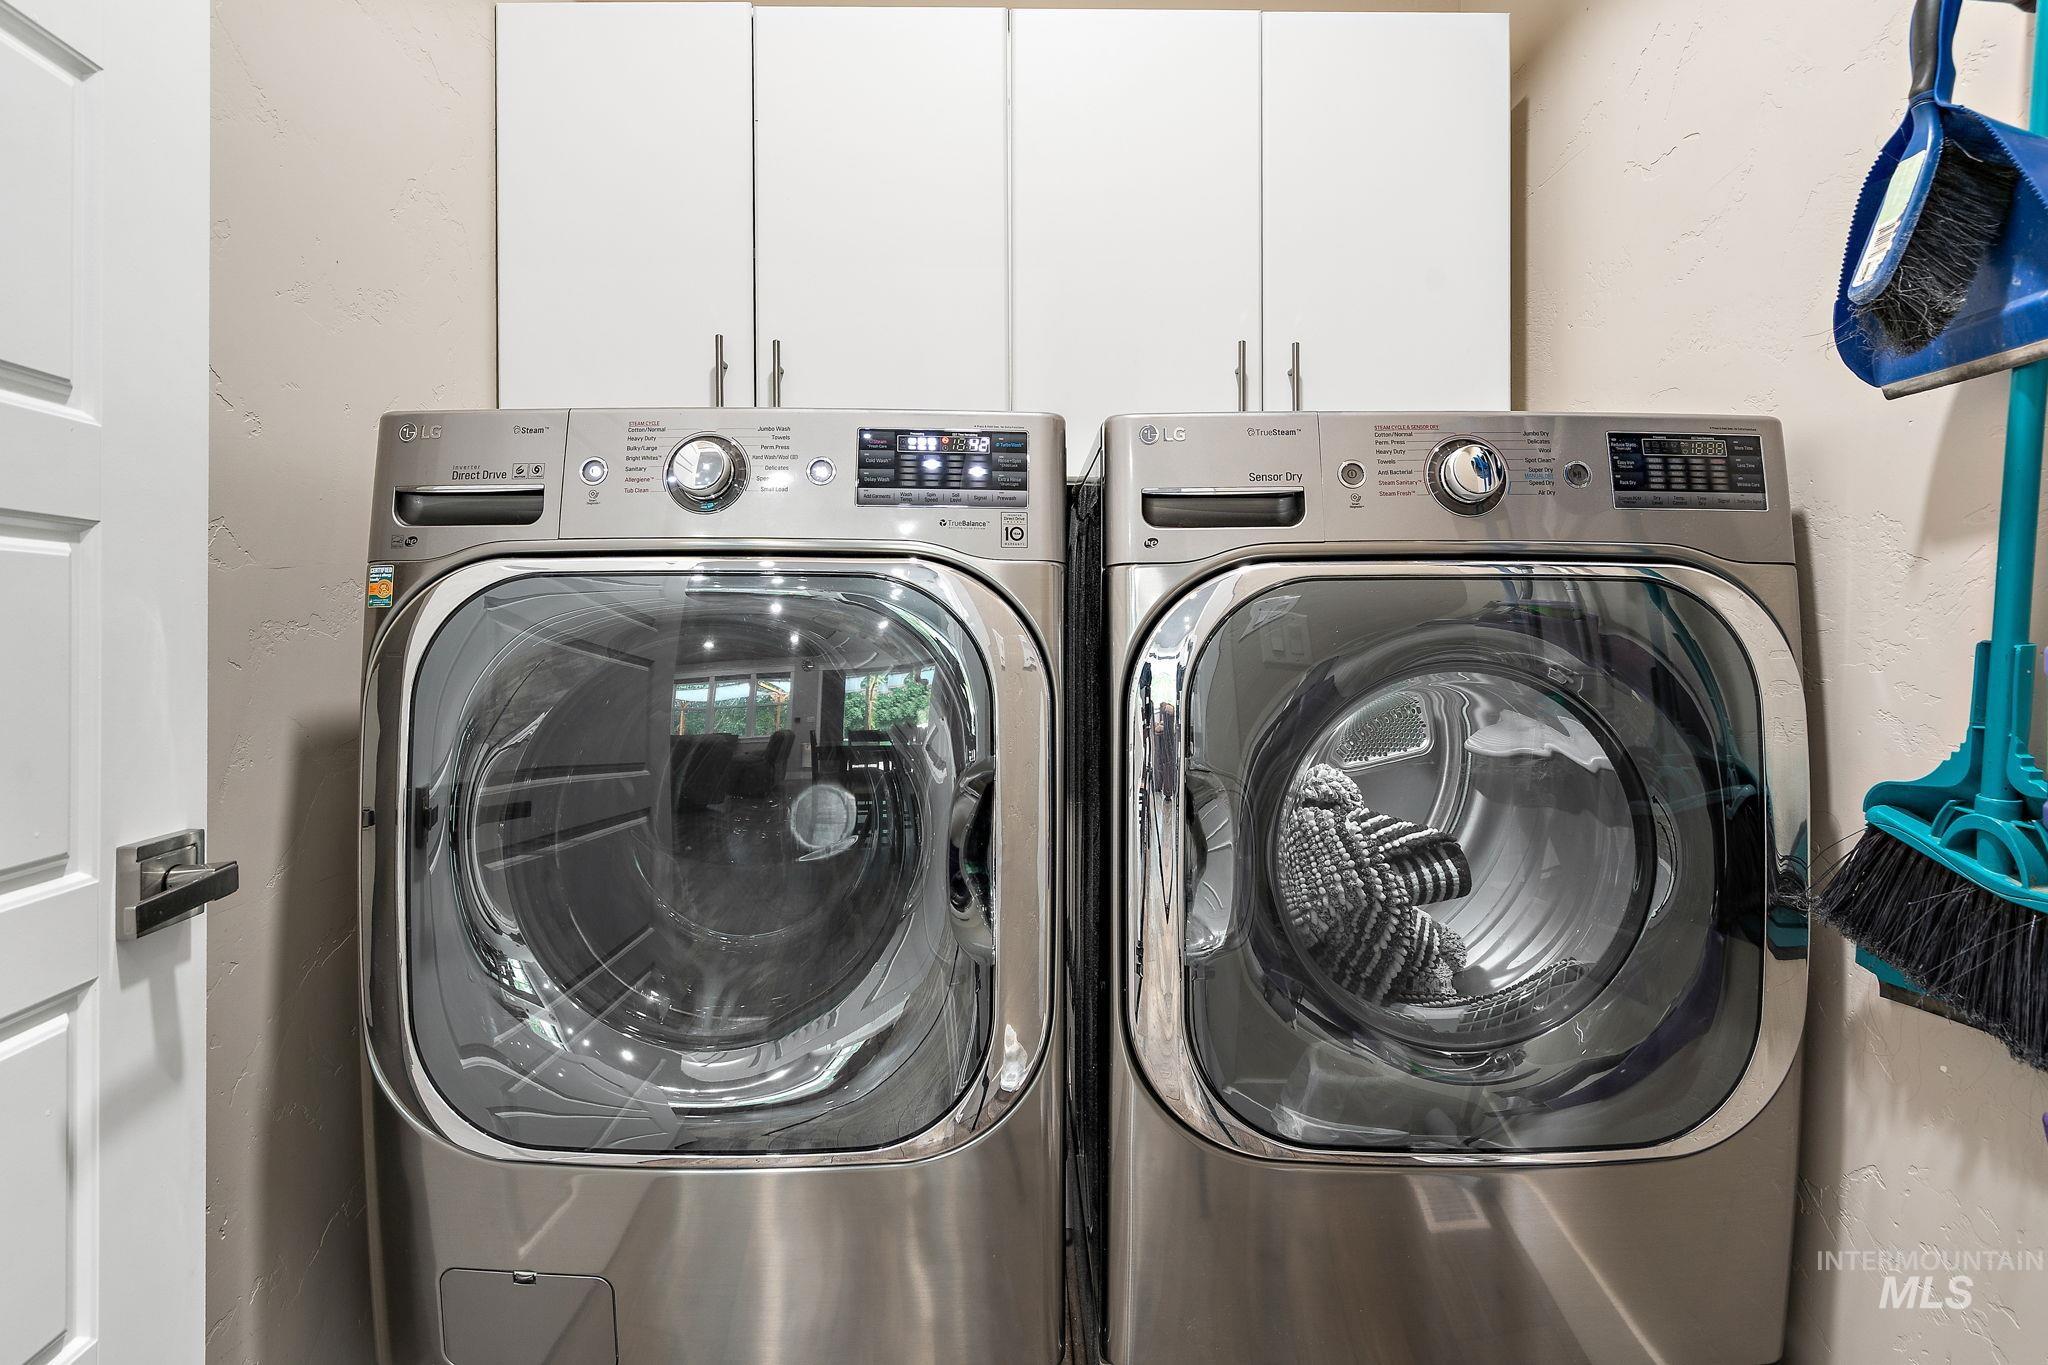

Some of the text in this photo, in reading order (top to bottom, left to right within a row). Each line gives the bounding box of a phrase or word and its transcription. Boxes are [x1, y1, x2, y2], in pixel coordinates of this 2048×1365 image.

[420, 424, 442, 439] LG
[1163, 427, 1186, 442] LG
[452, 470, 507, 480] Direct Drive
[1249, 472, 1303, 482] Sensor Dry
